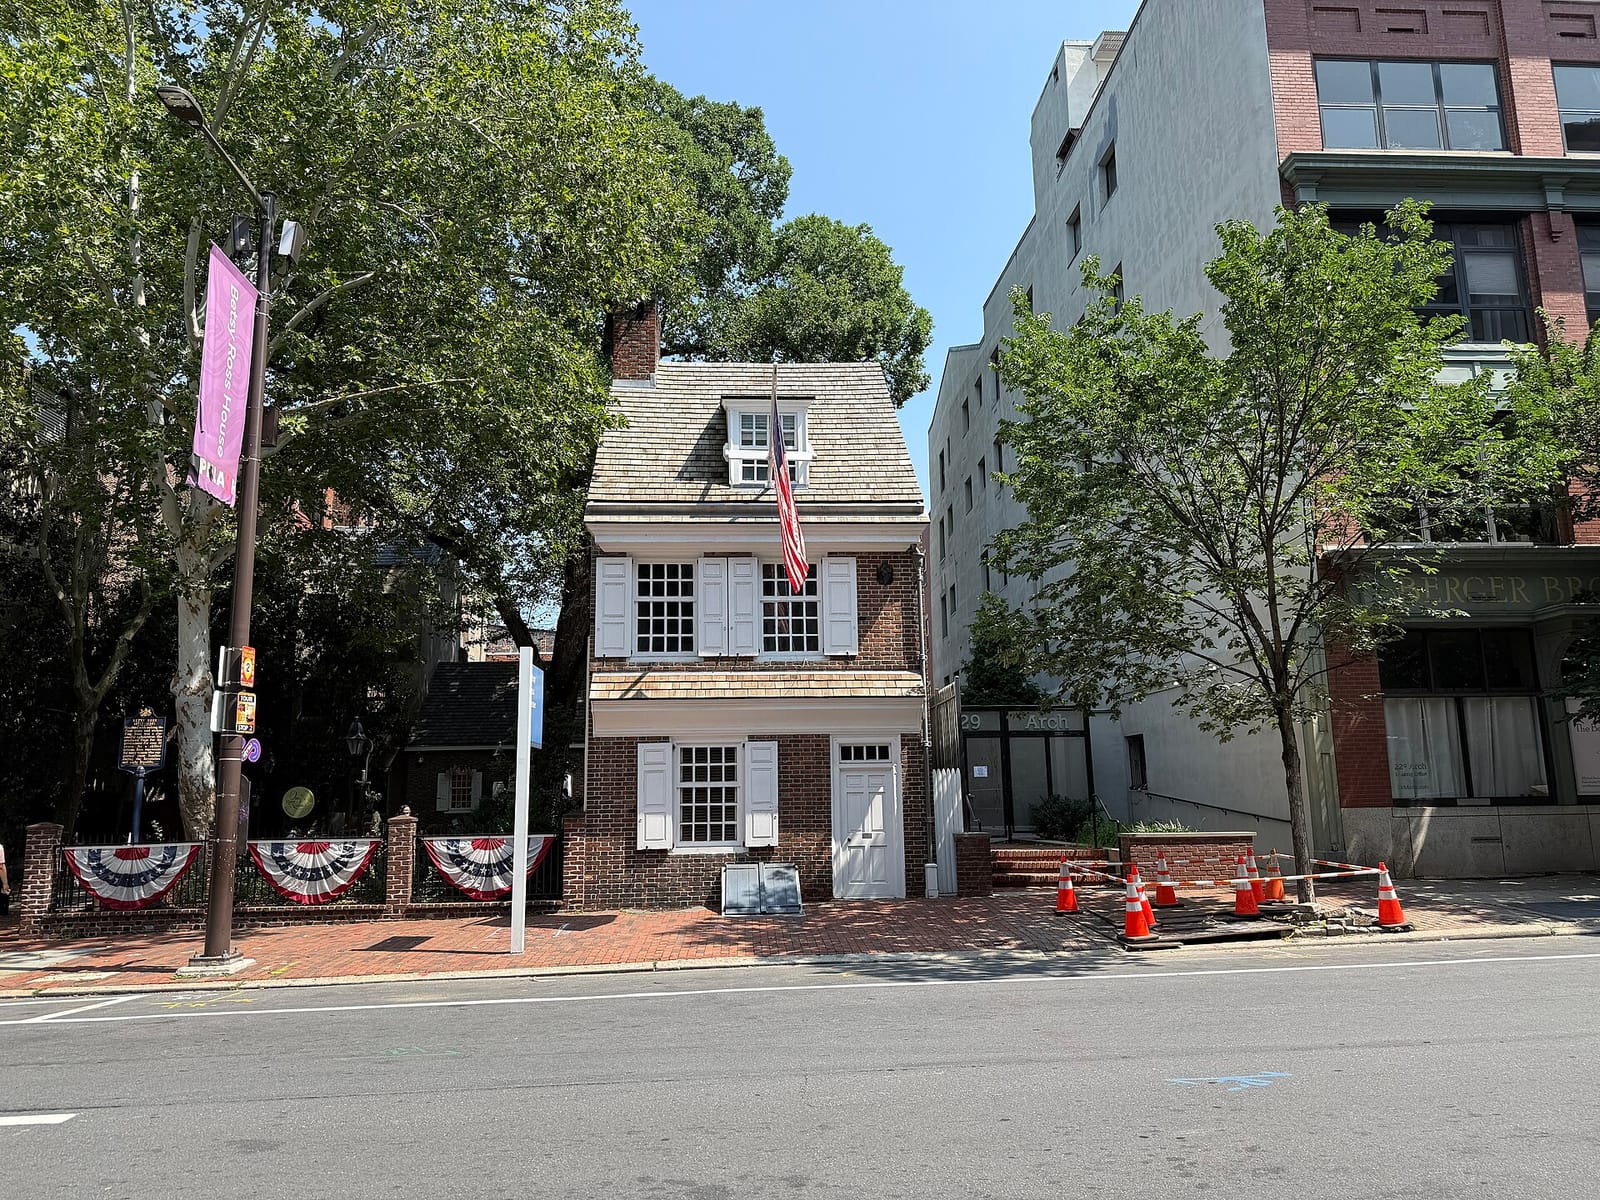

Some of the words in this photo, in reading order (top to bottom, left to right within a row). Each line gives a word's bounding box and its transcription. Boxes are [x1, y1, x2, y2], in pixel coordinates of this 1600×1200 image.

[227, 285, 239, 341] Betsy
[223, 343, 237, 390] Ross
[217, 394, 232, 457] House
[1400, 576, 1531, 603] BERGER
[1024, 713, 1069, 729] Arch
